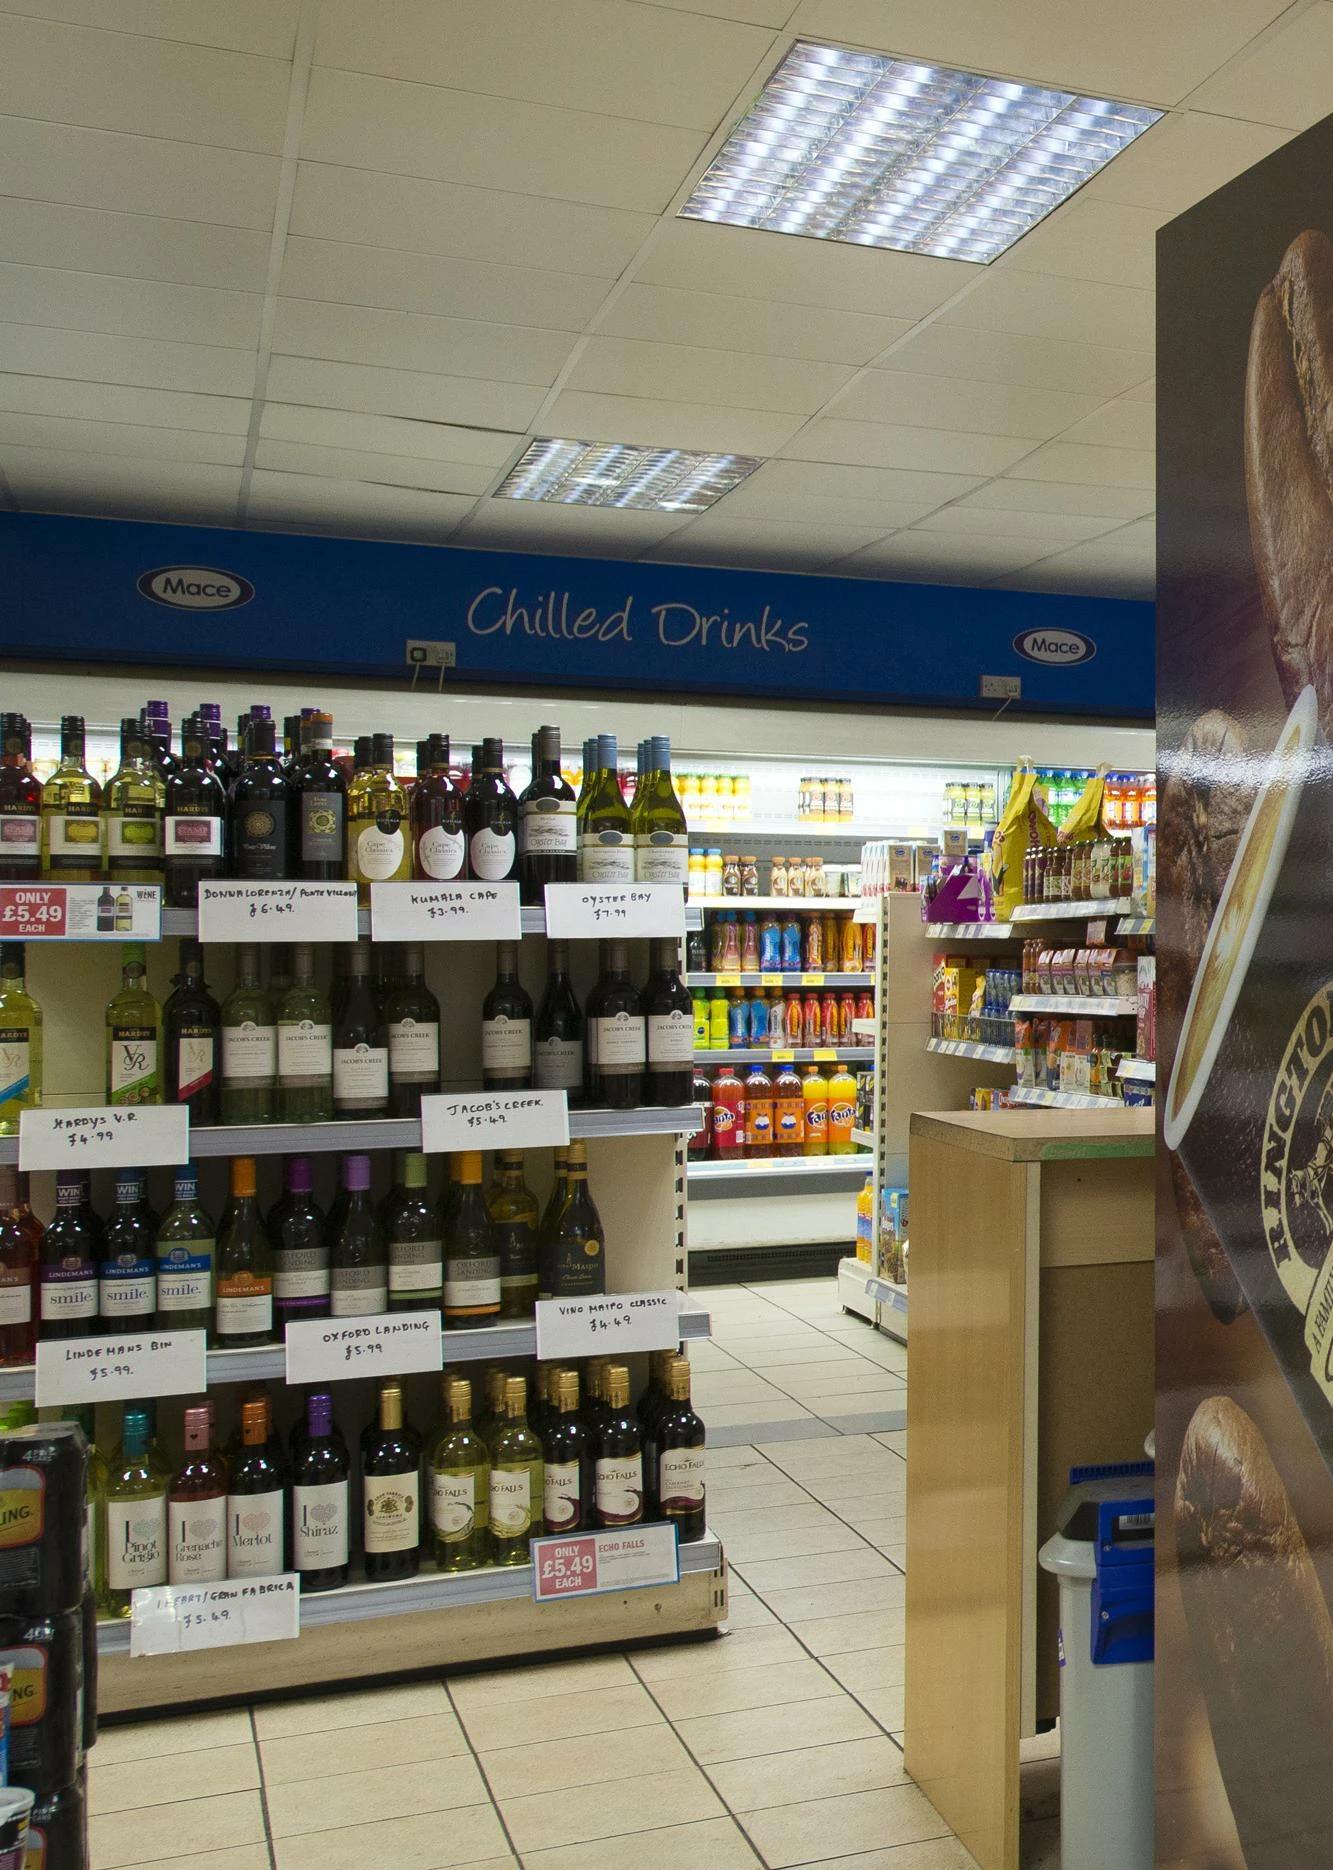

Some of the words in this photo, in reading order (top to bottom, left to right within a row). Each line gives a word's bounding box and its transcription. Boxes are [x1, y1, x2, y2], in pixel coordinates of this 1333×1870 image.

[163, 574, 233, 600] Mace
[466, 586, 634, 642] Chilled
[652, 602, 810, 653] Drinks
[1030, 636, 1080, 657] Mace
[16, 891, 52, 904] ONLY
[411, 893, 463, 904] KUMALA
[469, 890, 499, 901] CAPE
[582, 894, 626, 908] OYSTER
[630, 892, 652, 903] BAY
[2, 906, 62, 923] £5.49
[594, 908, 627, 920] £7.99
[19, 923, 46, 934] EACH
[446, 1100, 501, 1116] JACOB'S
[830, 1106, 857, 1121] Fanta
[53, 1114, 107, 1131] HARDYS
[67, 1130, 114, 1147] £4.99
[58, 1186, 81, 1197] WIN
[117, 1183, 139, 1195] WIN
[559, 1305, 586, 1316] VINO
[589, 1301, 623, 1313] MAIPO
[629, 1297, 668, 1309] CLASSIC
[322, 1326, 371, 1344] OXFORD
[375, 1320, 430, 1336] LANDING
[66, 1344, 142, 1362] LINDEMANS
[151, 1340, 173, 1351] BIN
[345, 1343, 383, 1361] £5.99
[615, 1469, 638, 1480] FALLS
[664, 1461, 687, 1472] ECHO
[231, 1531, 273, 1547] Merlot
[299, 1523, 340, 1539] Shiraz
[124, 1540, 158, 1553] Pinot
[554, 1544, 581, 1557] ONLY
[598, 1542, 621, 1553] ECHO
[621, 1538, 646, 1550] FALLS
[121, 1550, 161, 1566] Grigio
[541, 1555, 594, 1580] £5.49
[554, 1575, 583, 1590] EACH
